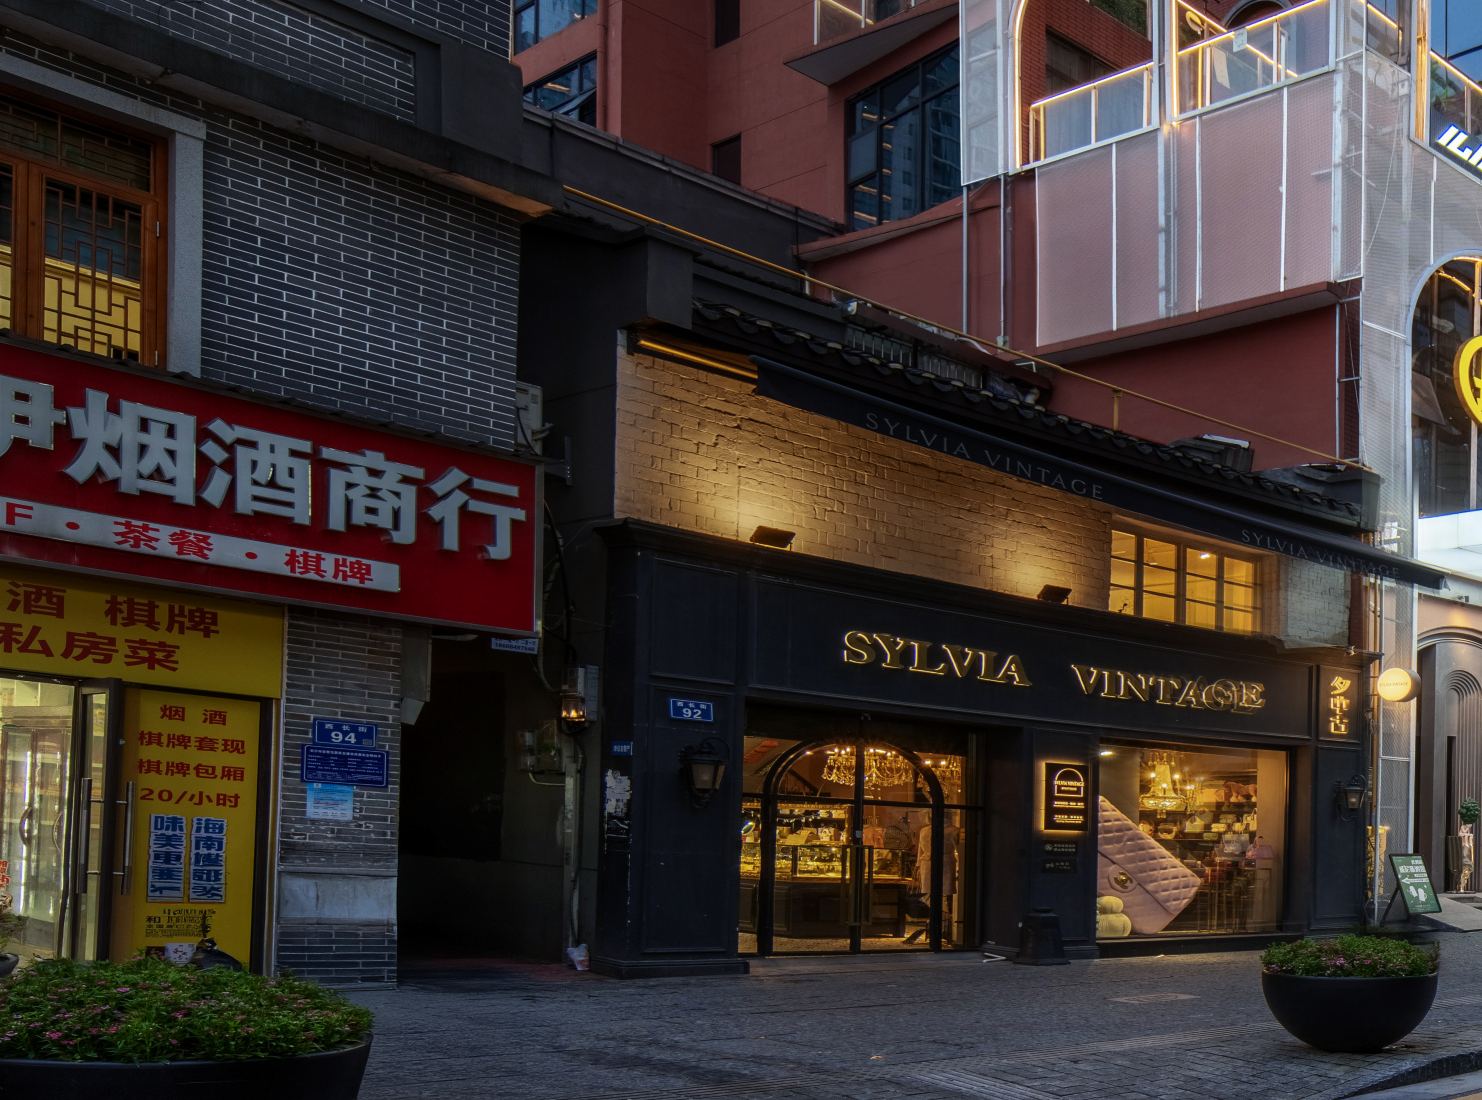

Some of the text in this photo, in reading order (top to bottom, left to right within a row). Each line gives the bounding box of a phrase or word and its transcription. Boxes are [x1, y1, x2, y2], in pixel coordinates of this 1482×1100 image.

[864, 412, 1103, 501] SYLVIA VINTAGE
[113, 521, 374, 585] 茶餐 棋牌
[1241, 529, 1309, 560] SYLVIA
[6, 580, 220, 639] 酒 棋牌
[0, 621, 180, 673] 私房菜
[844, 630, 1267, 716] SYLVIA VINTAGE
[160, 705, 228, 726] 烟酒
[682, 708, 703, 720] 92
[330, 731, 358, 745] 94
[140, 787, 241, 809] 20/小时
